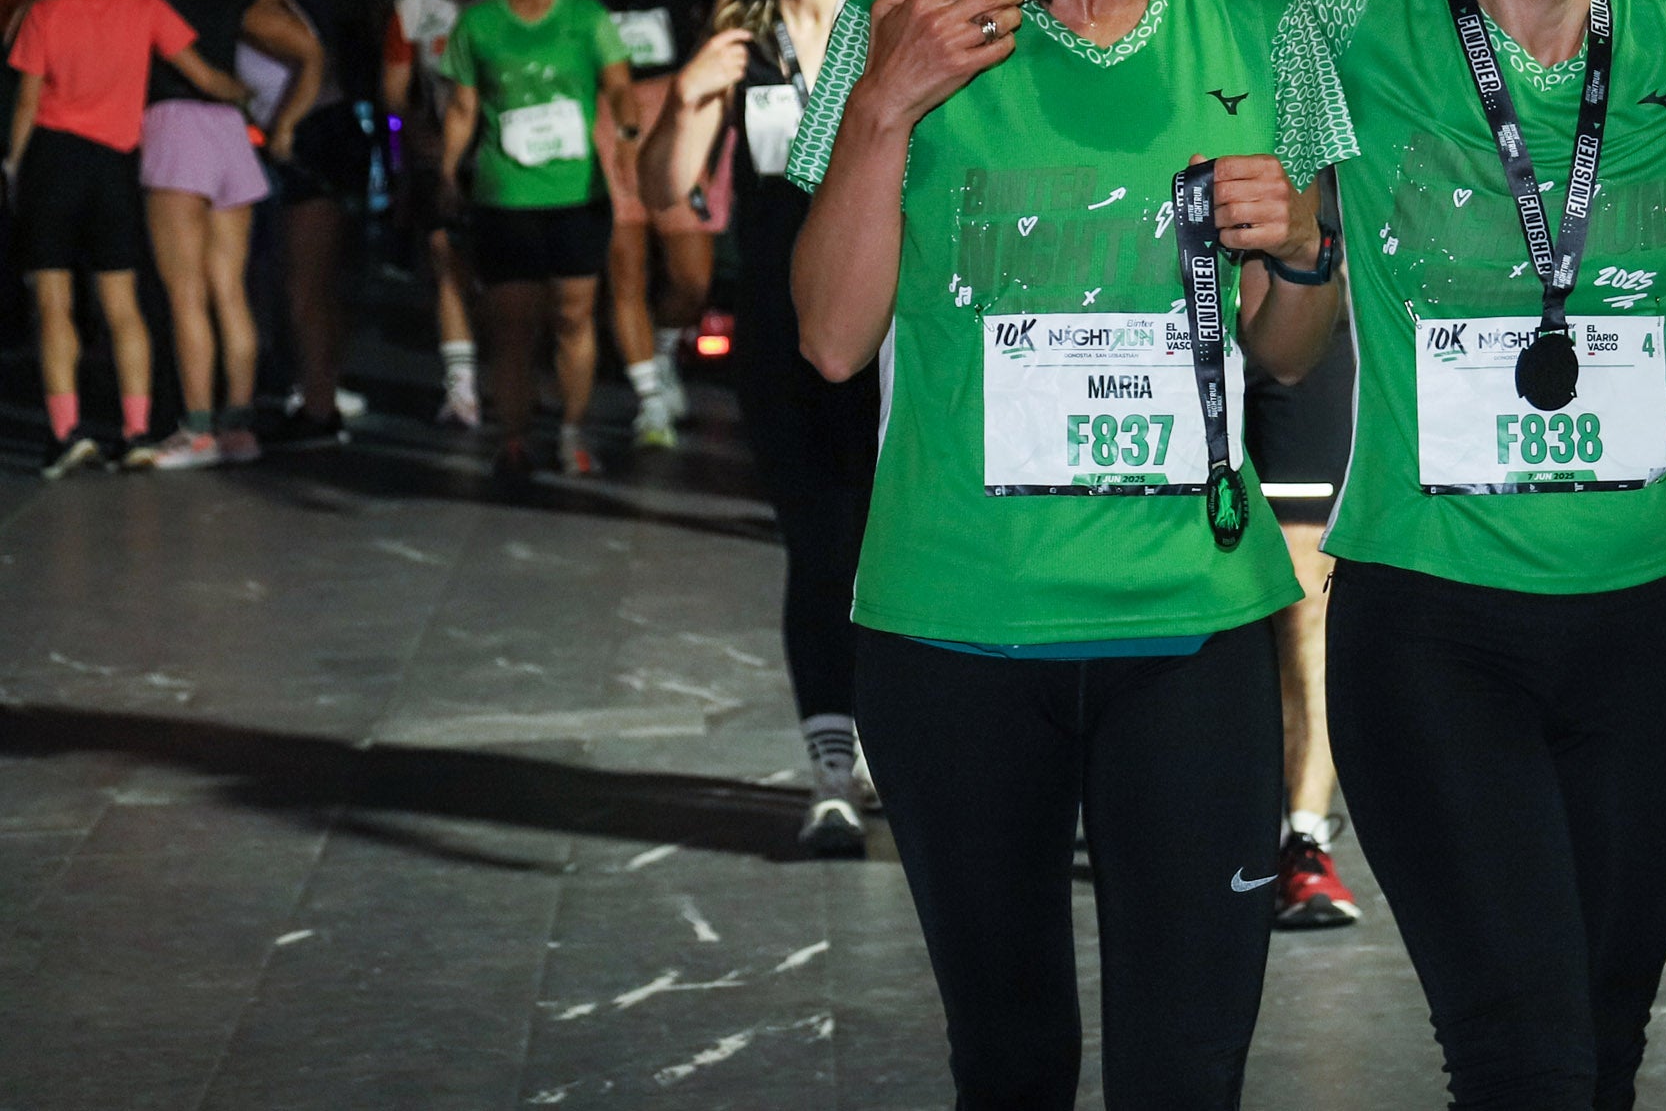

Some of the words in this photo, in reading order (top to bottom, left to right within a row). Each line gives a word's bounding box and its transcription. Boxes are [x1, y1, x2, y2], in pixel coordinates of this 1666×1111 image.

[1458, 13, 1500, 92] FINISHER
[1566, 134, 1598, 218] FINISHER
[1518, 194, 1553, 275] FINISHER
[1593, 266, 1657, 291] 2025
[1192, 256, 1220, 342] FINISHER
[1166, 323, 1177, 331] EL
[1587, 324, 1597, 332] EL
[1166, 332, 1191, 341] DIAR
[1586, 334, 1618, 342] DIARIO
[1166, 342, 1191, 350] VASC
[1588, 343, 1618, 351] VASCO
[1642, 333, 1655, 358] 4
[1067, 414, 1174, 466] F837
[1496, 412, 1603, 465] F838
[1102, 475, 1121, 484] JUN
[1122, 475, 1145, 484] 2025
[1554, 472, 1575, 480] 2025
